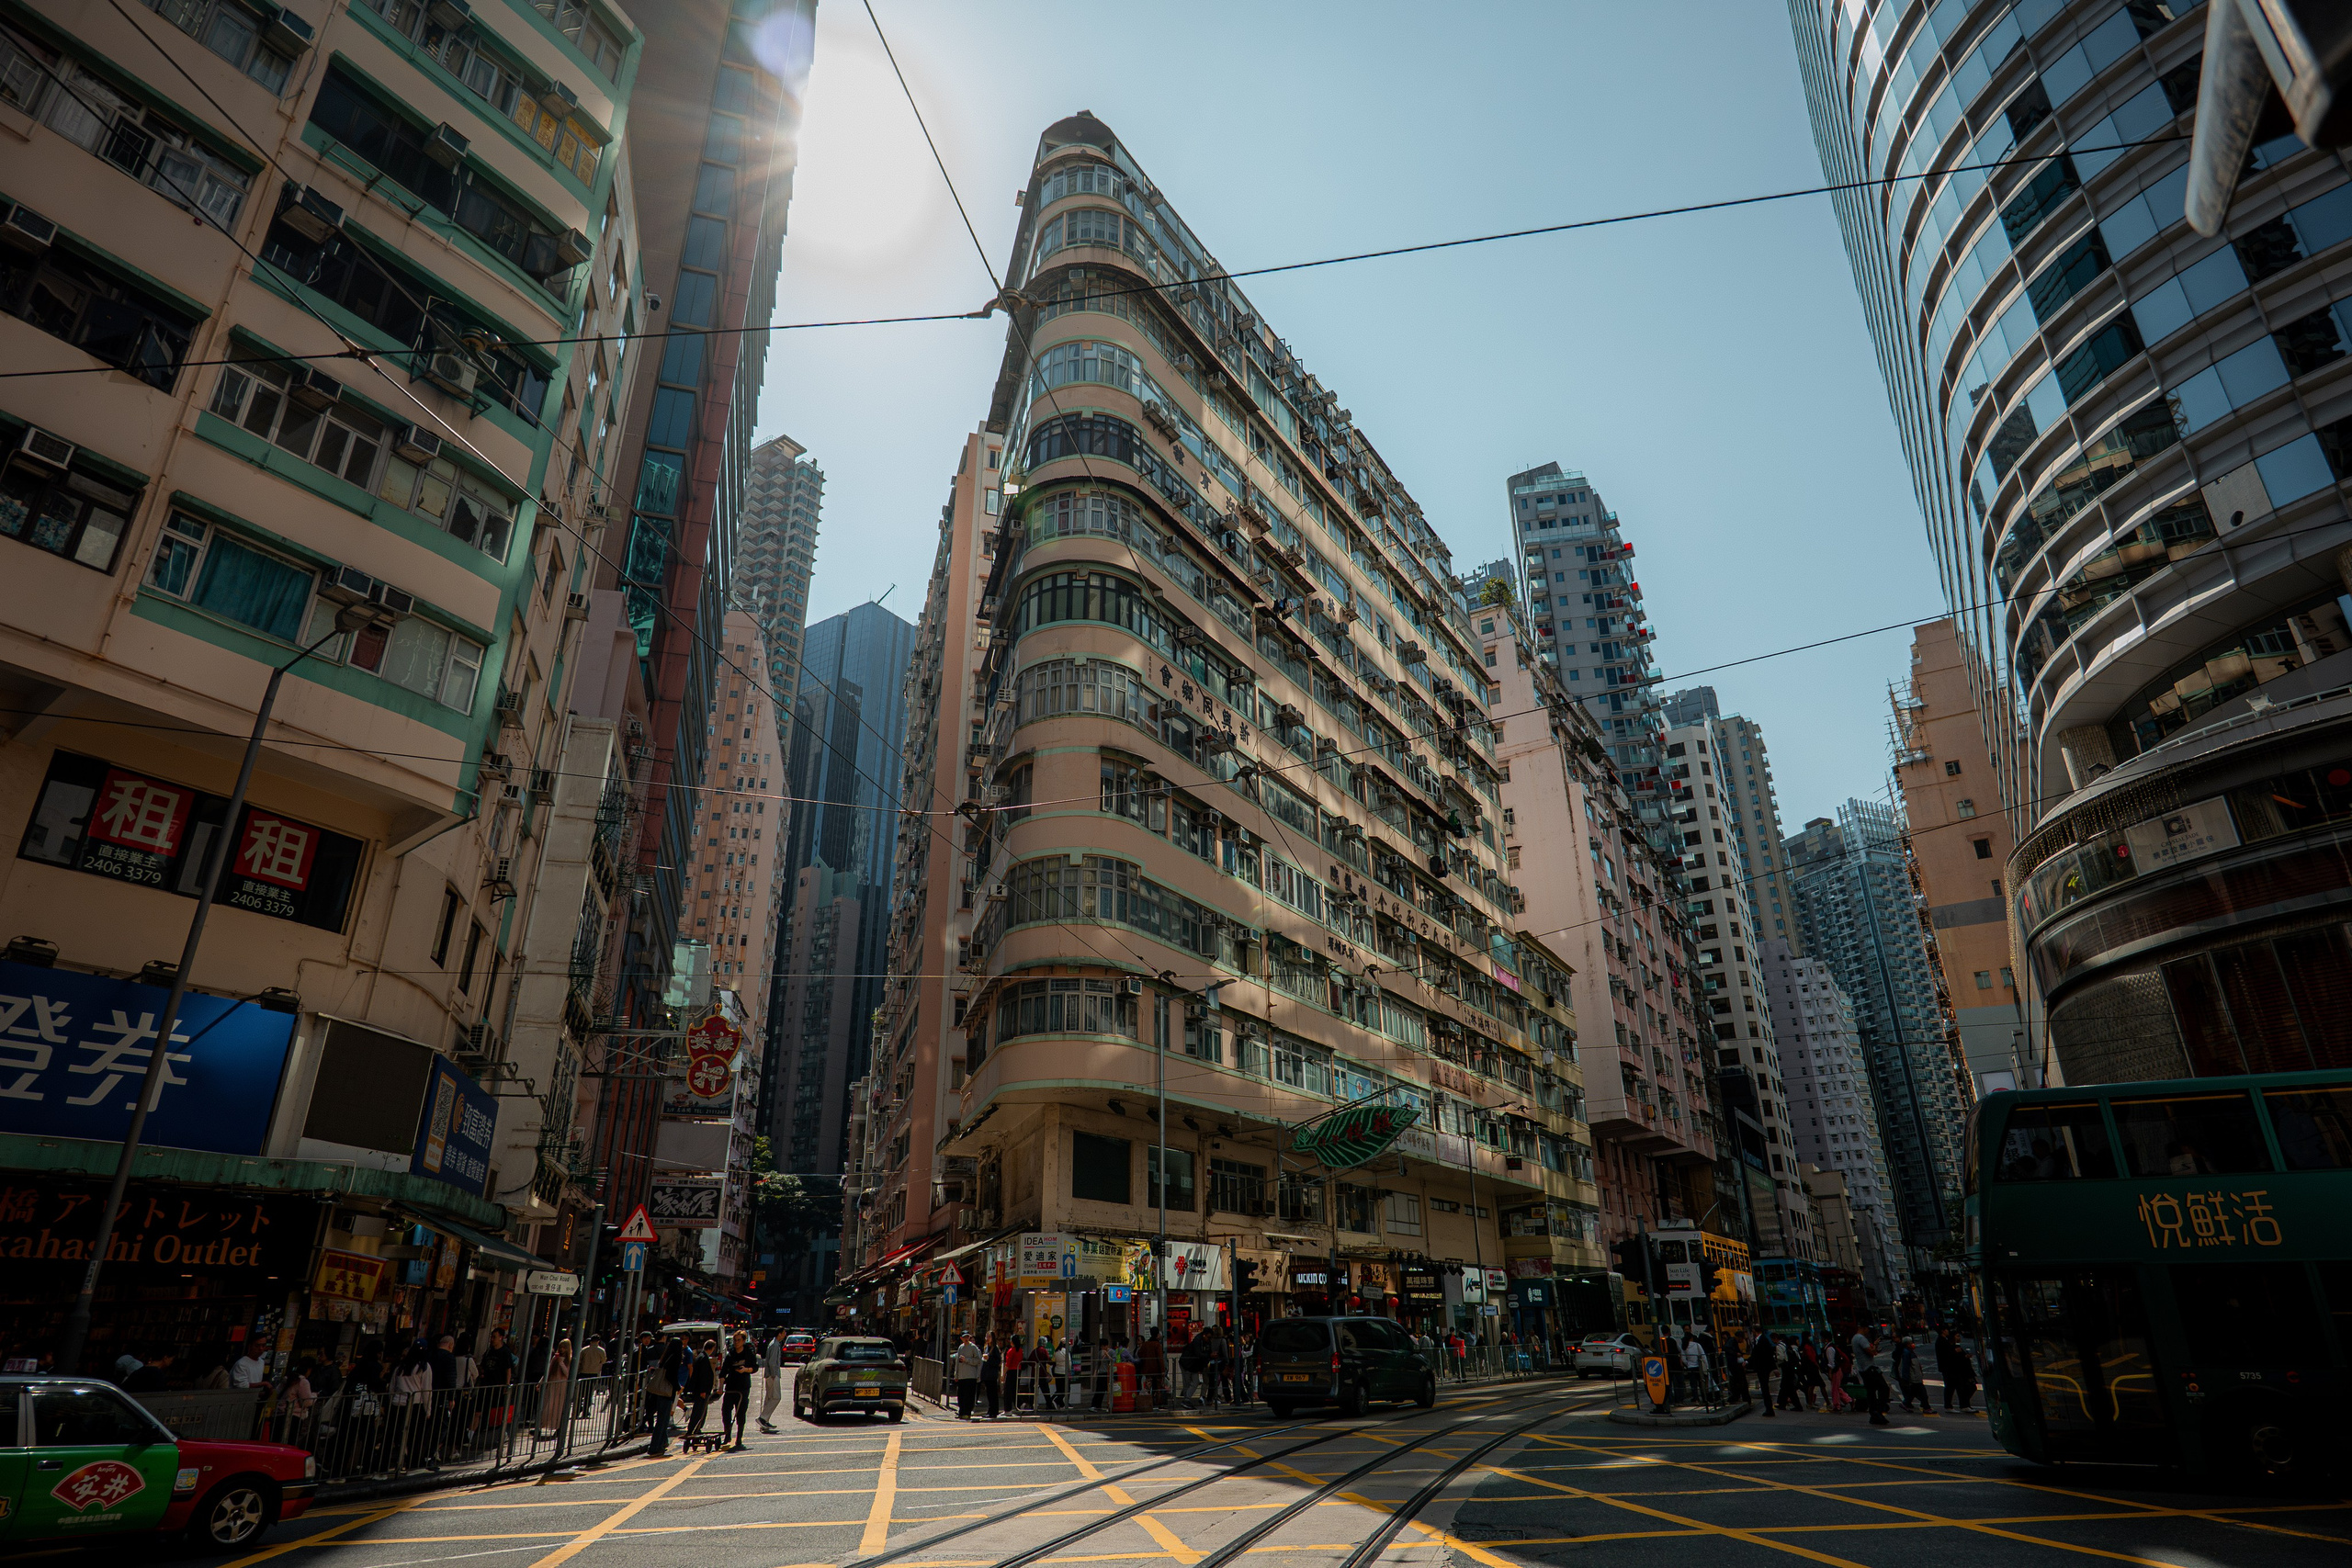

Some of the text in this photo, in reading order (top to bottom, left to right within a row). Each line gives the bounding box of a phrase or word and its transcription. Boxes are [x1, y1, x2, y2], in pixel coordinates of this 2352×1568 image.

[101, 779, 182, 850] 租
[96, 843, 158, 869] 直接業主
[243, 819, 310, 884] 租
[84, 856, 162, 885] 2406 3379
[231, 892, 295, 918] 2406 3379
[242, 881, 291, 903] 直接業主
[693, 1061, 725, 1092] 押
[2138, 1190, 2283, 1248] 悅鮮活
[153, 1234, 263, 1267] Outlet
[1023, 1236, 1044, 1246] IDEA
[1023, 1251, 1057, 1261] 愛迪家
[2240, 1371, 2262, 1381] 5735
[96, 1465, 117, 1473] Anjoy
[72, 1473, 130, 1502] 安井
